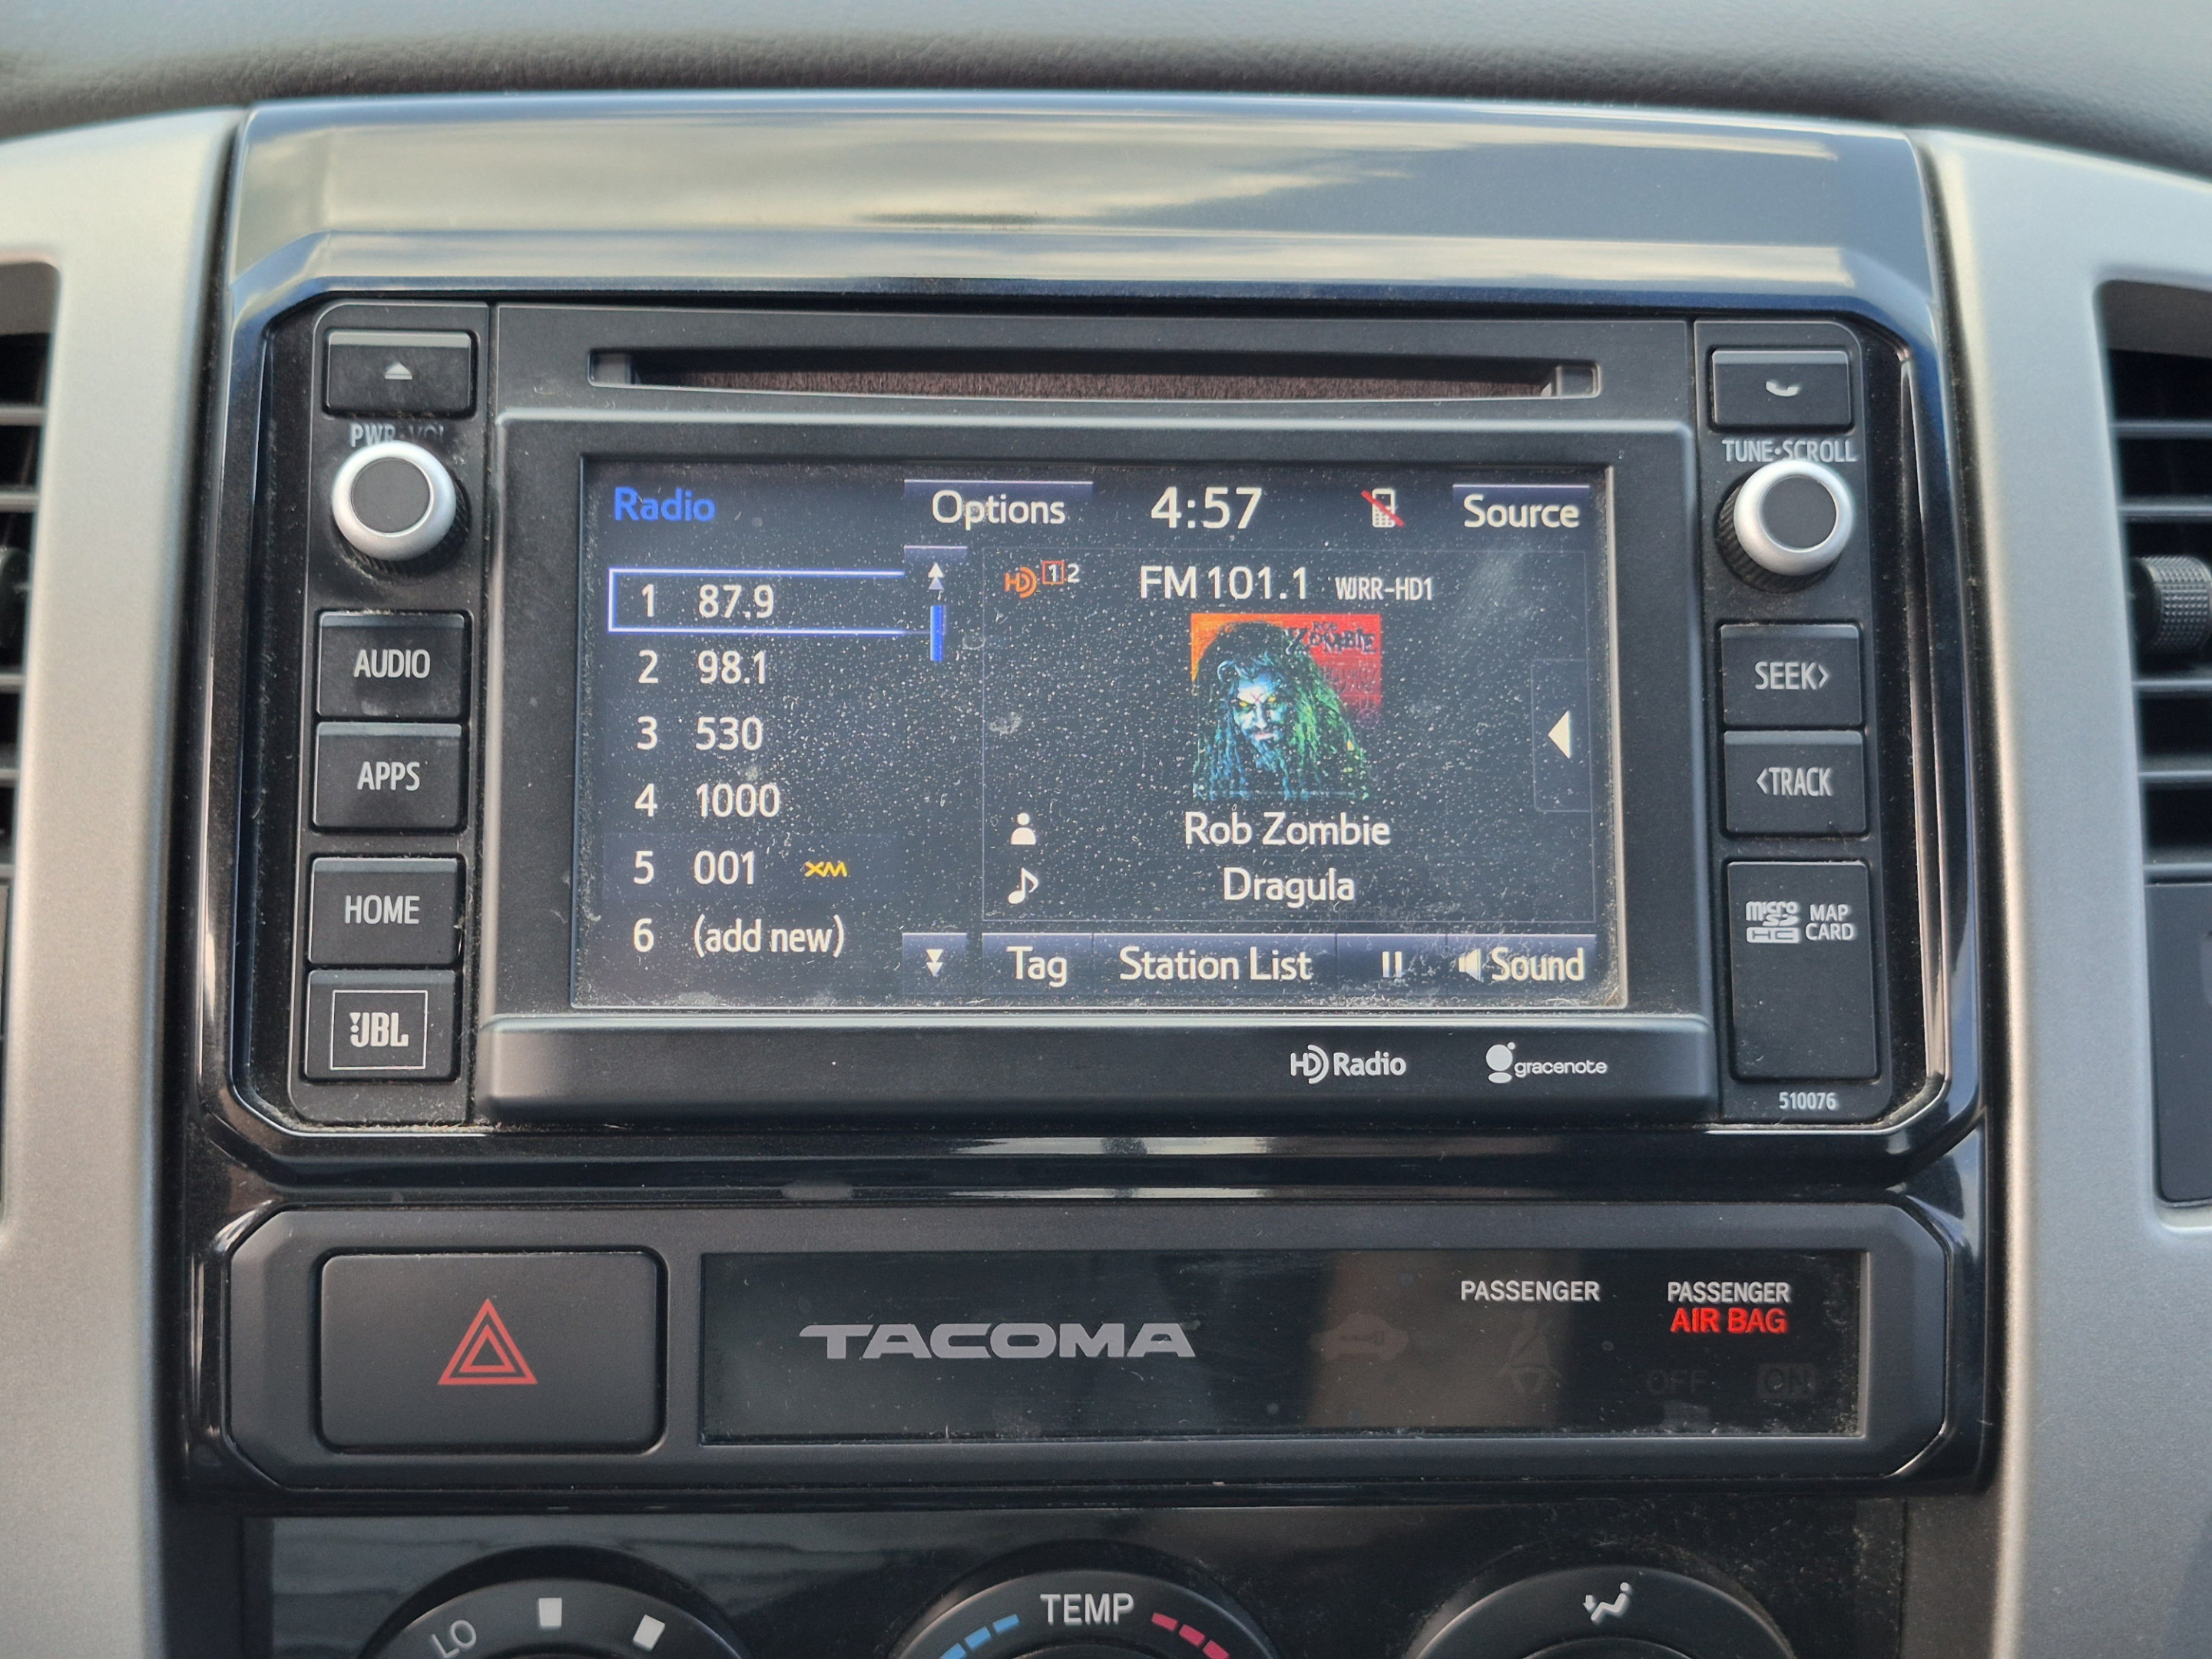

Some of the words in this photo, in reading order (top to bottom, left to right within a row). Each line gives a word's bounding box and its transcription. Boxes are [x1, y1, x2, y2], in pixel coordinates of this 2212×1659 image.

[614, 486, 716, 522] Radio
[932, 489, 1066, 530] Options
[1151, 486, 1263, 529] 4:57
[1463, 494, 1581, 528] Source
[1068, 563, 1080, 583] 2
[1141, 566, 1197, 599] FM
[1207, 566, 1307, 600] 101.1
[1335, 577, 1432, 601] WJRR-HD1
[642, 584, 654, 618] 1
[699, 584, 775, 618] 87.9
[353, 649, 430, 678] AUDIO
[638, 650, 658, 684] 2
[698, 651, 766, 684] 98.1
[1755, 661, 1817, 690] SEEK
[637, 716, 657, 750] 3
[695, 717, 763, 750] 530
[356, 761, 420, 791] APPS
[1769, 767, 1833, 796] TRACK
[634, 783, 657, 817] 4
[696, 783, 780, 818] 1000
[1185, 812, 1251, 845] Rob
[1263, 812, 1391, 846] Zombie
[633, 850, 654, 885] 5
[694, 850, 754, 885] 001
[1224, 867, 1356, 909] Dragula
[346, 895, 420, 924] HOME
[1810, 904, 1851, 922] MAP
[633, 918, 654, 952] 6
[694, 914, 761, 958] (add
[771, 914, 844, 958] new)
[1806, 922, 1856, 941] CARD
[1006, 946, 1067, 987] Tag
[1119, 946, 1240, 980] Station
[1250, 946, 1312, 981] List
[1491, 947, 1584, 982] Sound
[349, 1012, 409, 1048] JBL
[1290, 1045, 1330, 1084] HD
[1333, 1050, 1407, 1077] Radio
[1515, 1058, 1608, 1078] gracenote
[1779, 1091, 1837, 1111] 510076
[1460, 1280, 1601, 1302] PASSENGER
[1667, 1282, 1791, 1303] PASSENGER
[1670, 1308, 1719, 1333] AIR
[1727, 1308, 1787, 1333] BAG
[799, 1323, 1196, 1359] TACOMA
[1040, 1593, 1134, 1626] TEMP
[431, 1619, 477, 1658] LO
